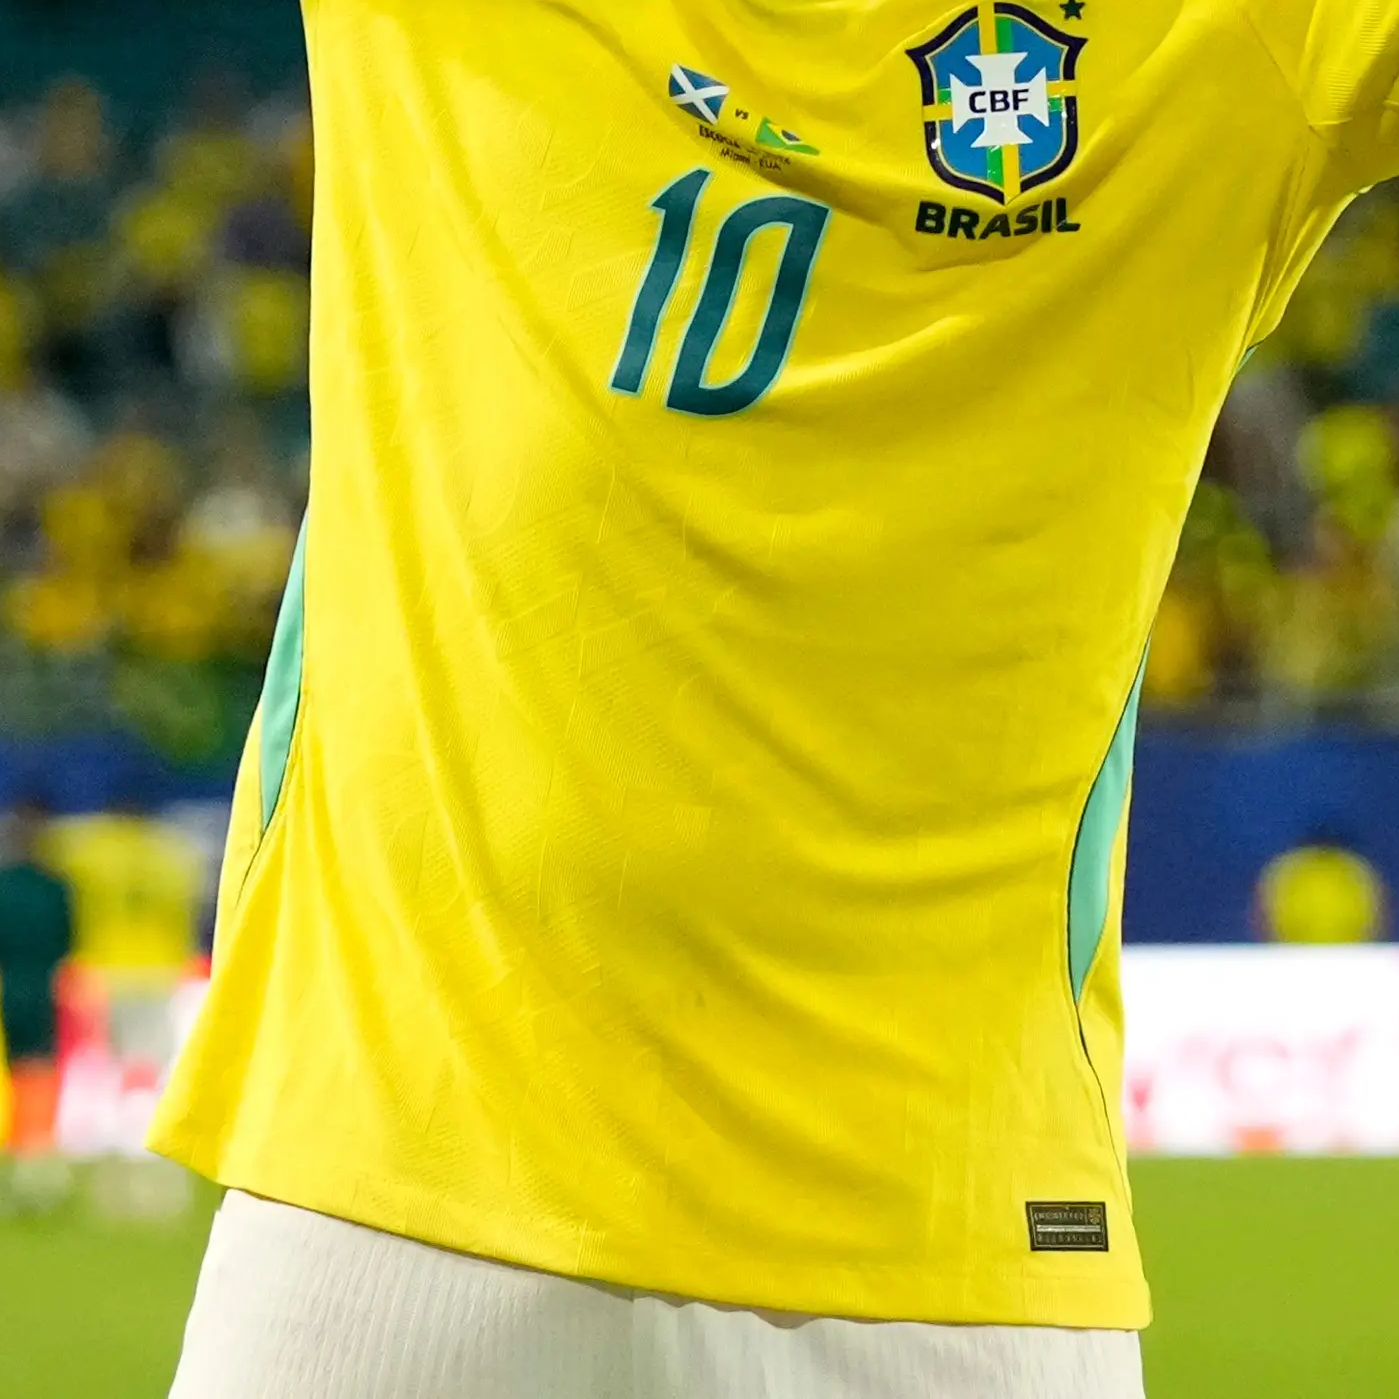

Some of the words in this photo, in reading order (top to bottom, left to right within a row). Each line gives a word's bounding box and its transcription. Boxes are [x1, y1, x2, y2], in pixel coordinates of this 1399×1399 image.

[968, 89, 1029, 114] CBF
[915, 198, 1081, 241] BRASIL
[609, 166, 832, 418] 10
